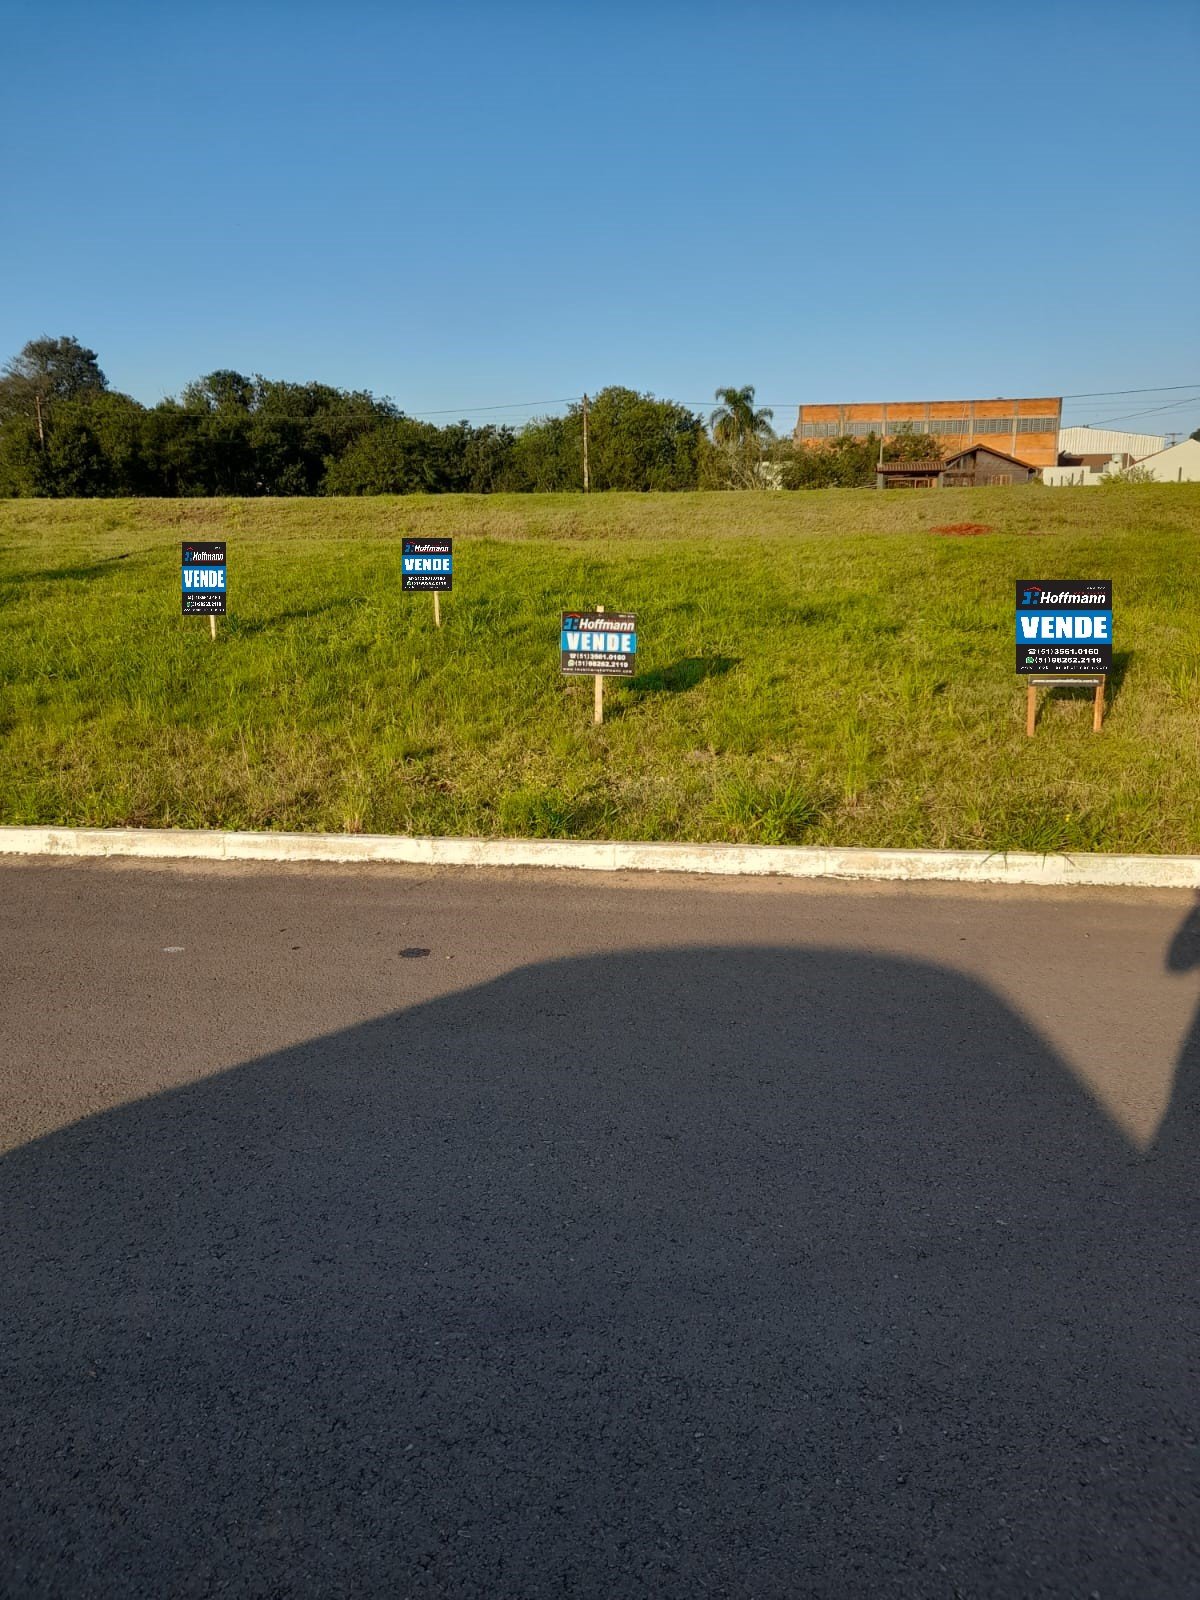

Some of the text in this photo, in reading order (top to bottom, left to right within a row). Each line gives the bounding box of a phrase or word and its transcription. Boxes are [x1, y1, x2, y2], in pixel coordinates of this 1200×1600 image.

[404, 558, 450, 571] VENDE
[183, 569, 225, 588] VENDE
[1039, 591, 1106, 604] Hoffmann
[579, 618, 635, 631] Hoffmann
[1020, 616, 1108, 639] VENDE
[566, 631, 632, 653] VENDE
